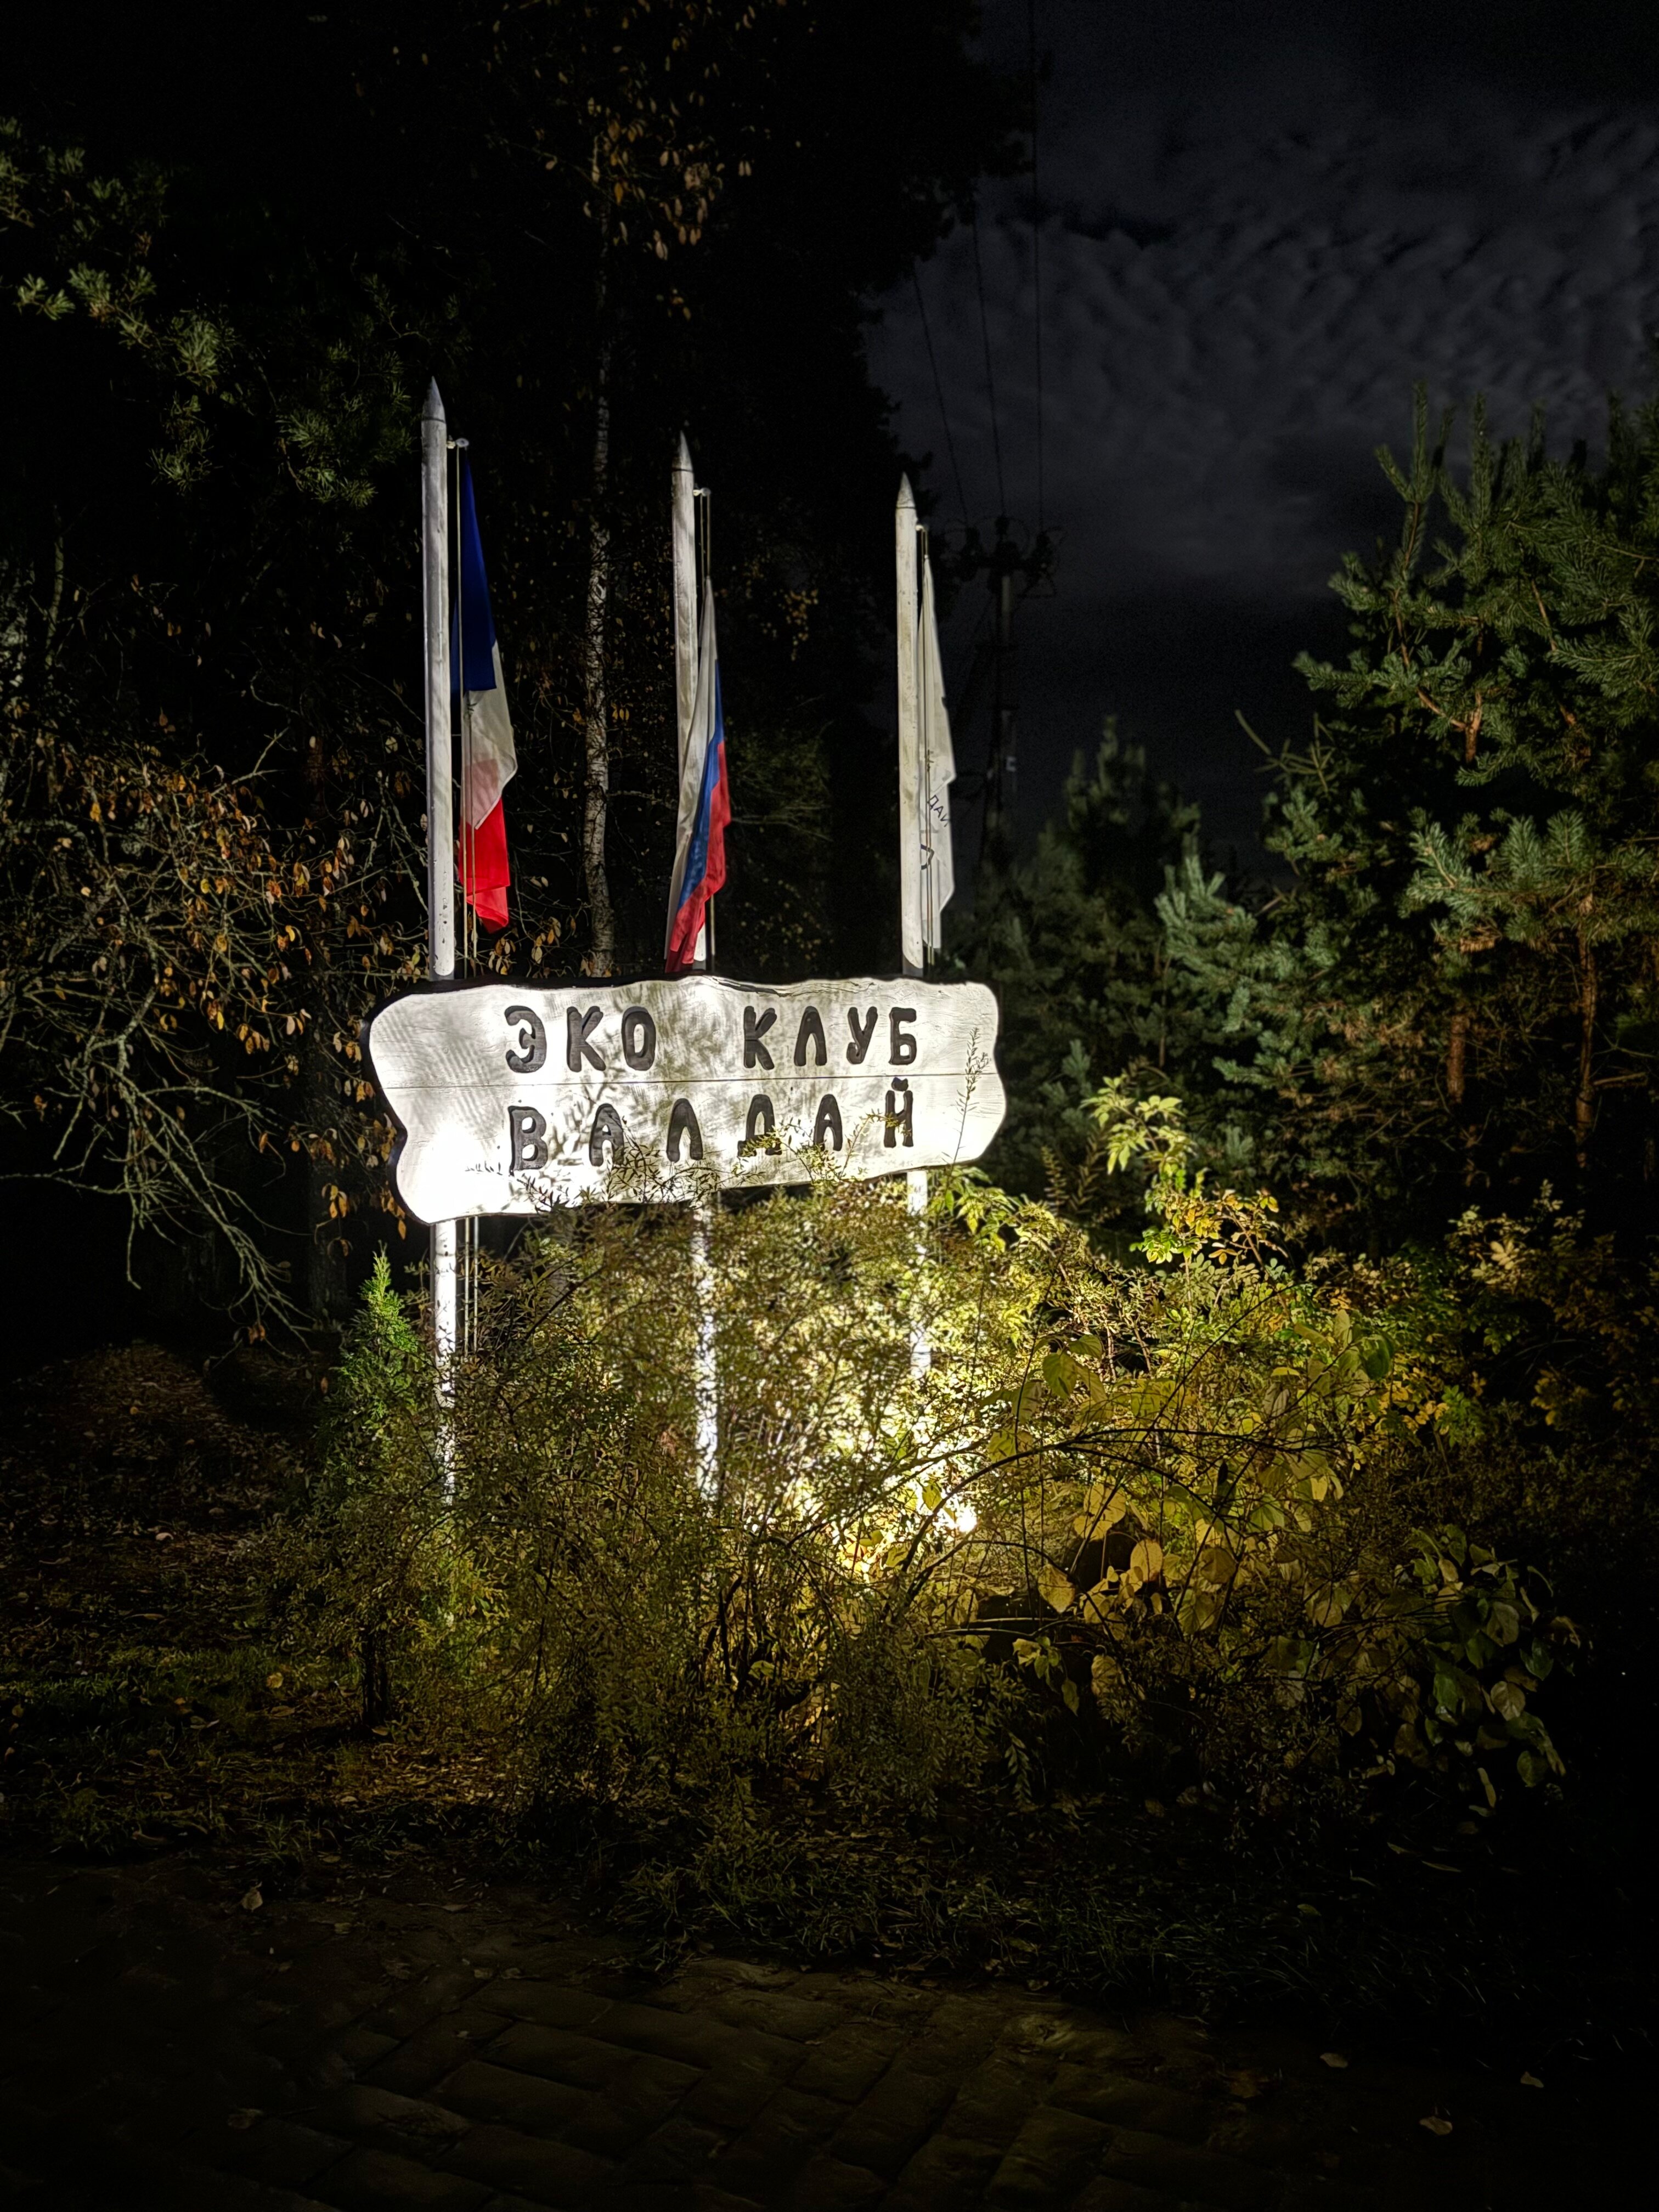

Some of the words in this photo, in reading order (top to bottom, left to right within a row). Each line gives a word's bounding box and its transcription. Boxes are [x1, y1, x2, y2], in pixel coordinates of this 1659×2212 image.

[504, 1005, 657, 1074] ЭКО
[743, 1006, 917, 1070] КЛУБ
[507, 1076, 914, 1175] ВАЛДАЙ
